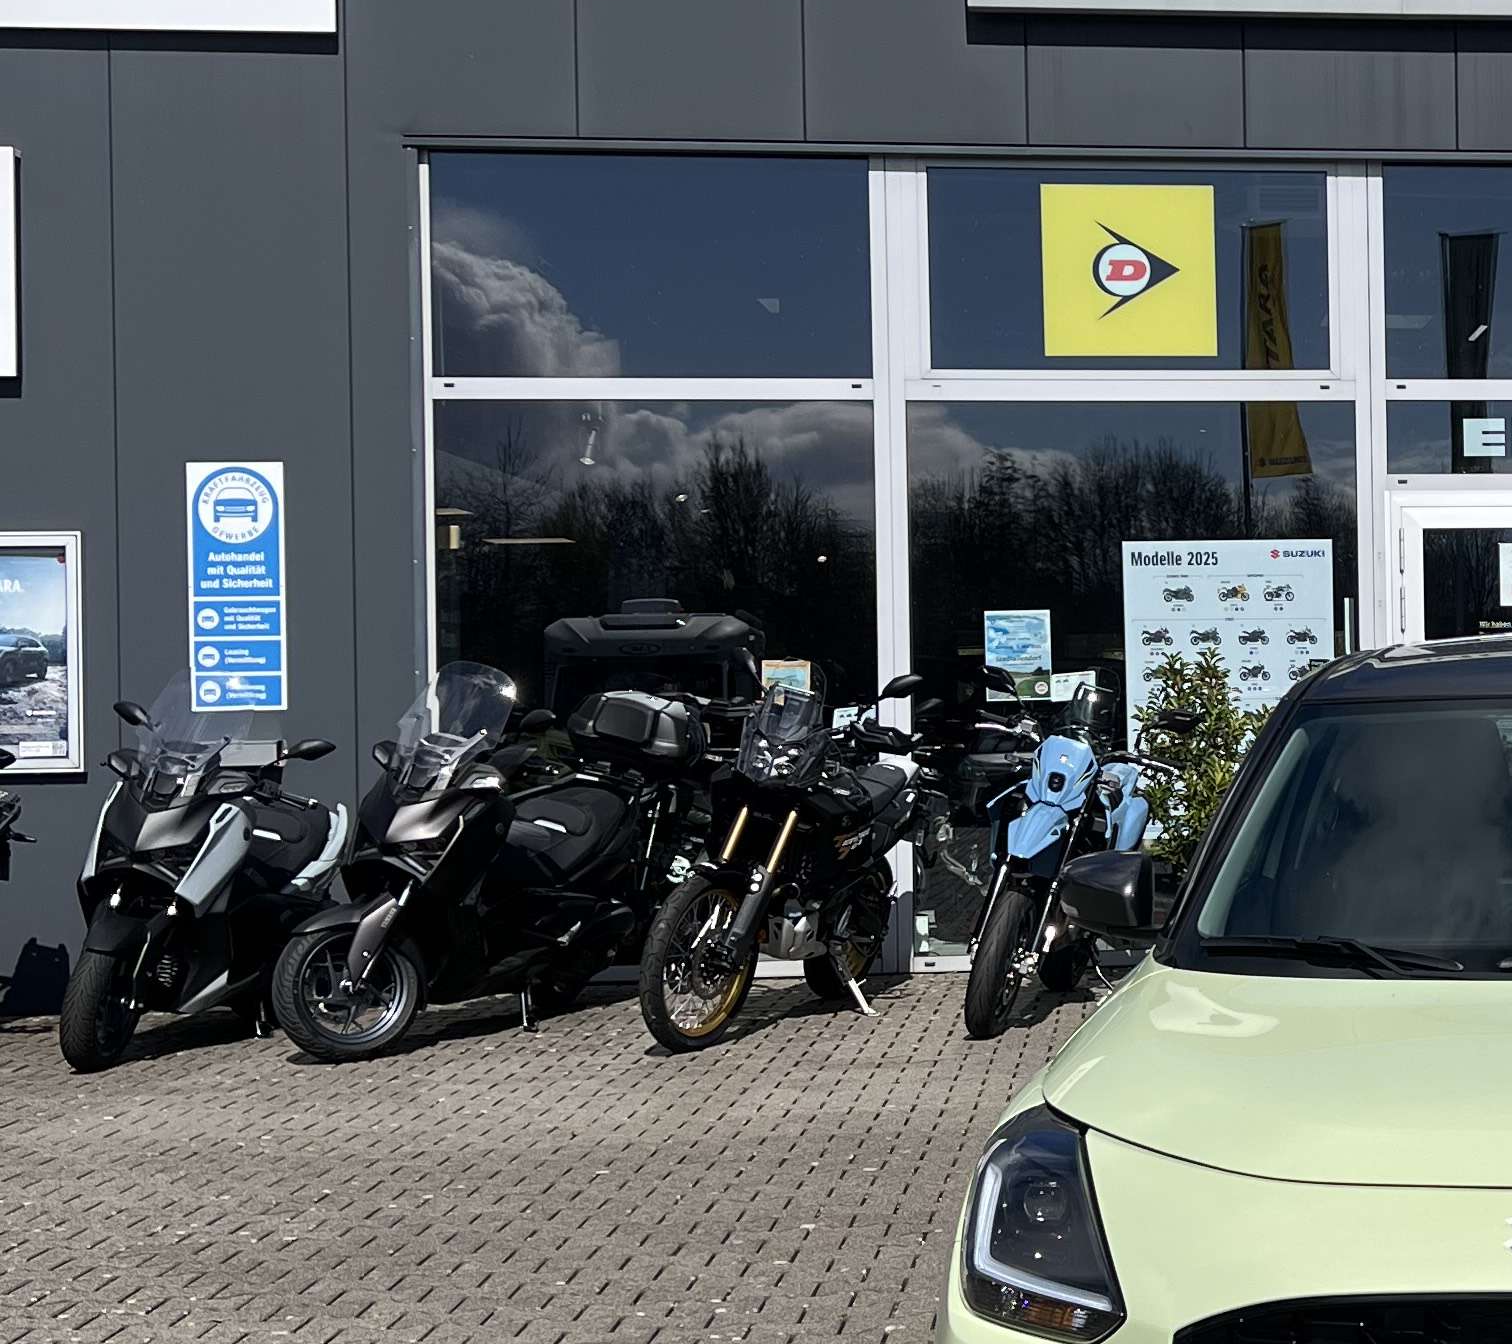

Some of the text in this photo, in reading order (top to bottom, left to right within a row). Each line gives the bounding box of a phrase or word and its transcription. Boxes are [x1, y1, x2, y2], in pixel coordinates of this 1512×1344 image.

[1105, 259, 1147, 282] D
[208, 551, 265, 562] Autohandel
[1130, 551, 1219, 567] Modelle 2025
[1282, 549, 1326, 558] SUZUKI
[207, 564, 267, 575] mit Qualität
[200, 578, 273, 589] und Sicherheit
